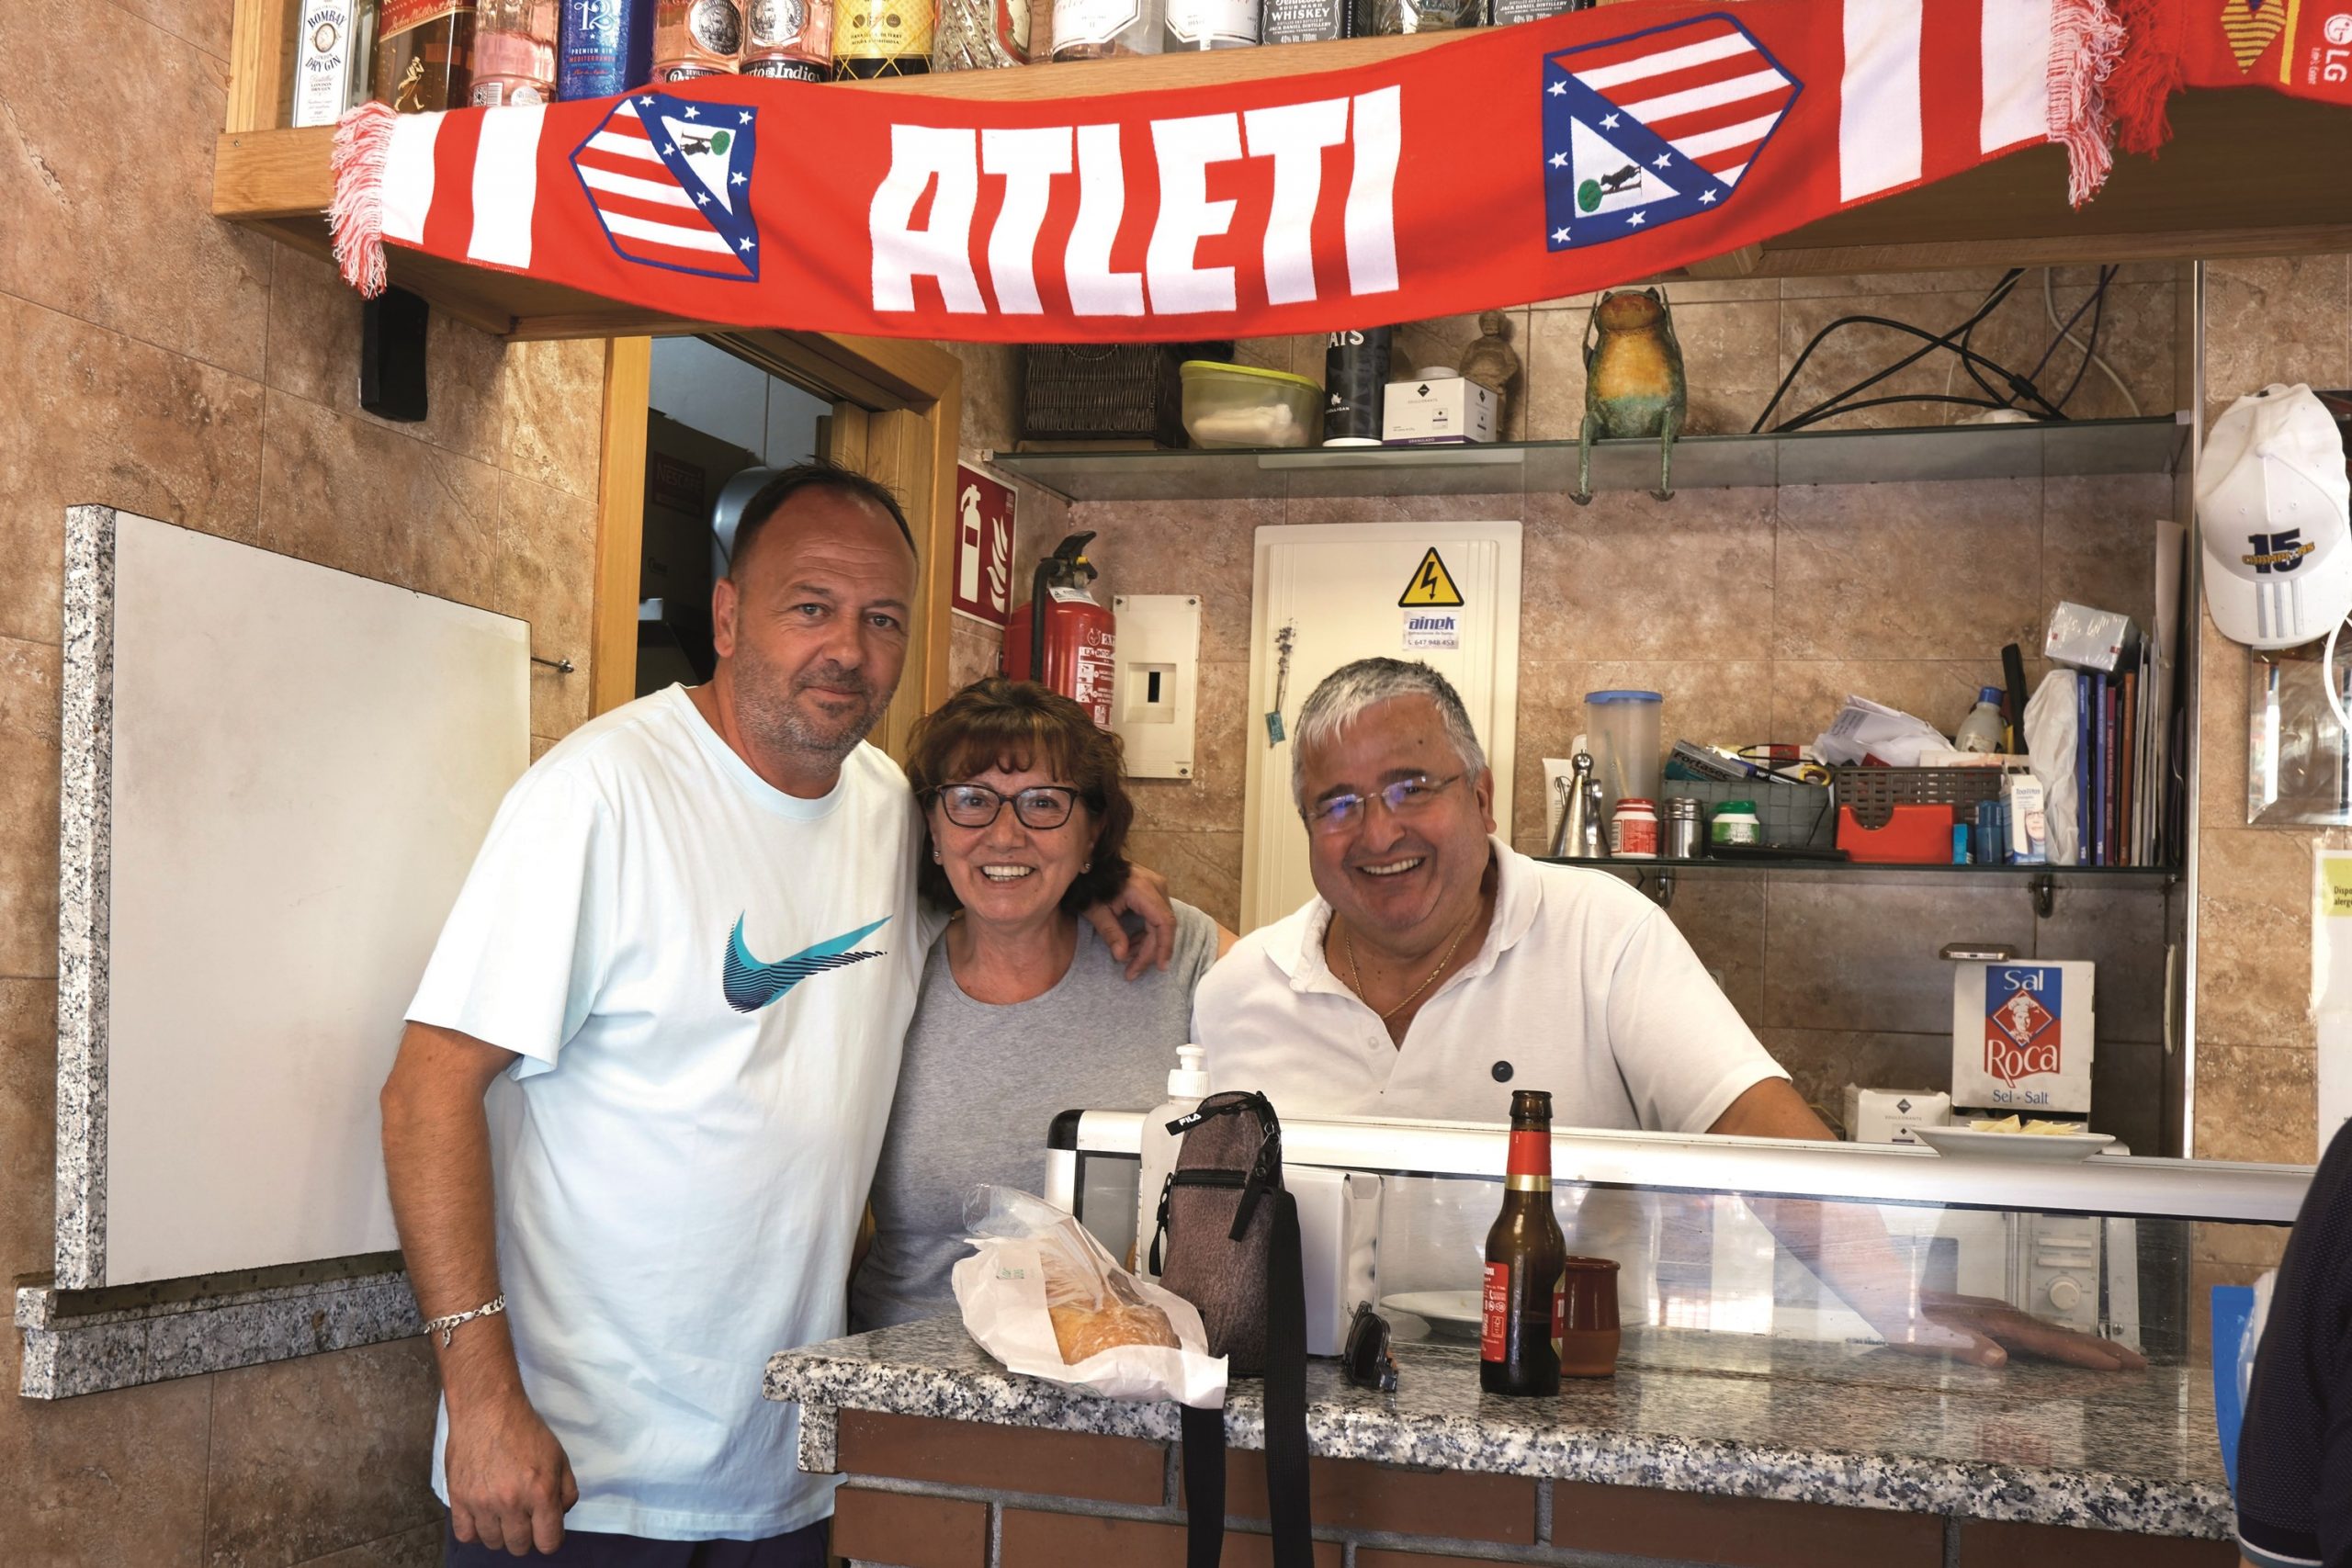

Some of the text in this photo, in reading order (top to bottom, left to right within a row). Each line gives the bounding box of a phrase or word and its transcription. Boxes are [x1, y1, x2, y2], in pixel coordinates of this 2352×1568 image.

[307, 9, 347, 28] BOMBAY
[574, 0, 616, 30] 12
[1272, 7, 1330, 22] WHISKEY
[305, 55, 342, 73] DRY GIN
[2324, 49, 2350, 83] LG
[869, 84, 1401, 316] ATLETI
[2247, 527, 2301, 574] 15
[1408, 616, 1455, 630] ainek
[1673, 750, 1731, 779] Fortasec
[2003, 969, 2044, 991] Sal
[1986, 1039, 2059, 1089] Roca
[1993, 1089, 2013, 1102] Sel
[2024, 1090, 2049, 1104] Salt
[1179, 1112, 1202, 1126] FILA
